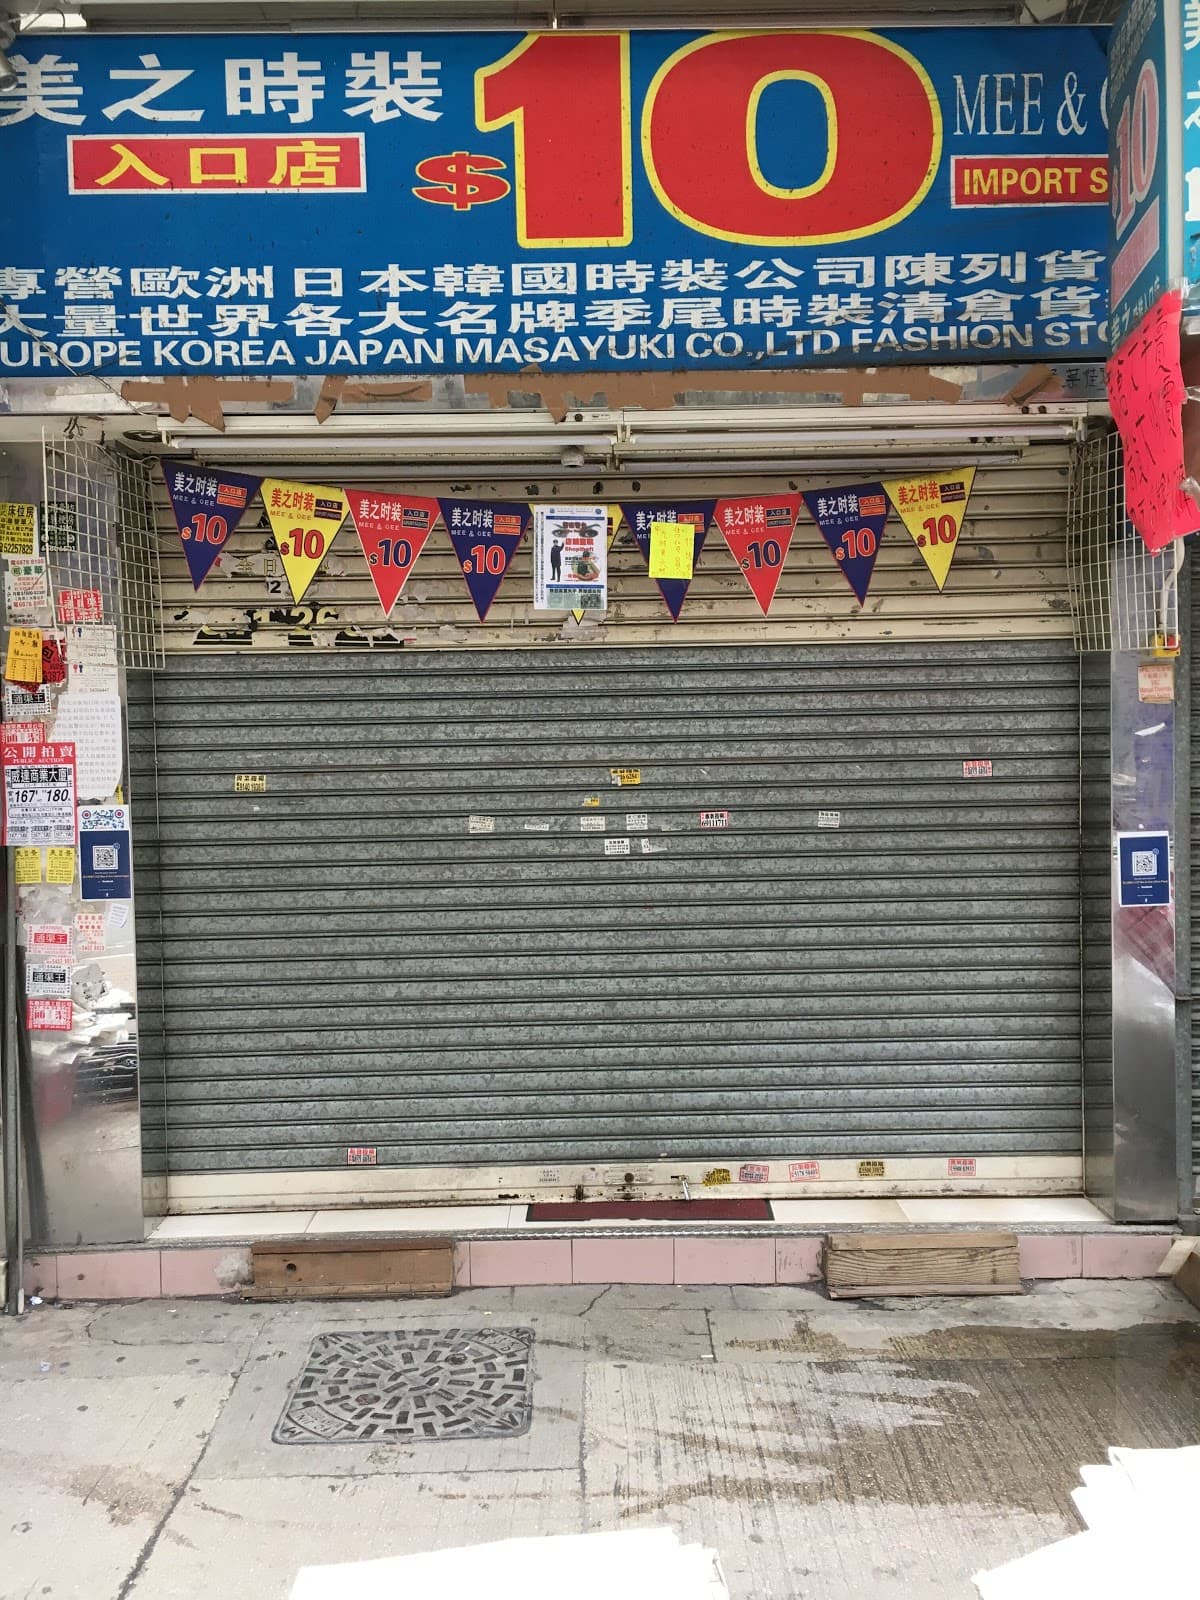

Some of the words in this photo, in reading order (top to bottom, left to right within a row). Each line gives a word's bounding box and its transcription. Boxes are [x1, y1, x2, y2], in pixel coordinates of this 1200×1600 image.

[0, 51, 443, 125] 美之時裝
[953, 72, 1043, 136] MEE
[1056, 71, 1087, 136] &
[95, 141, 341, 186] 入口店
[963, 167, 1079, 196] IMPORT
[0, 285, 1108, 338] 大量世界各大名牌季尾時裝清倉貨
[154, 339, 296, 366] KOREA
[305, 338, 445, 365] JAPAN
[455, 331, 675, 364] MASAYUKI
[851, 323, 1033, 353] FASHION
[174, 472, 217, 497] 美之时装
[898, 481, 939, 505] 美之时装
[271, 488, 316, 512] 美之时装
[360, 498, 402, 521] 美之时装
[817, 494, 858, 518] 美之时装
[181, 513, 228, 545] $10
[452, 507, 494, 528] 美之时装
[724, 505, 765, 527] 美之时装
[917, 514, 956, 547] $10
[280, 527, 325, 559] $10
[369, 538, 412, 568] $10
[741, 540, 781, 569] $10
[836, 528, 876, 560] $10
[463, 545, 506, 575] $10
[4, 745, 73, 758] 公開拍賣
[47, 789, 69, 802] 180
